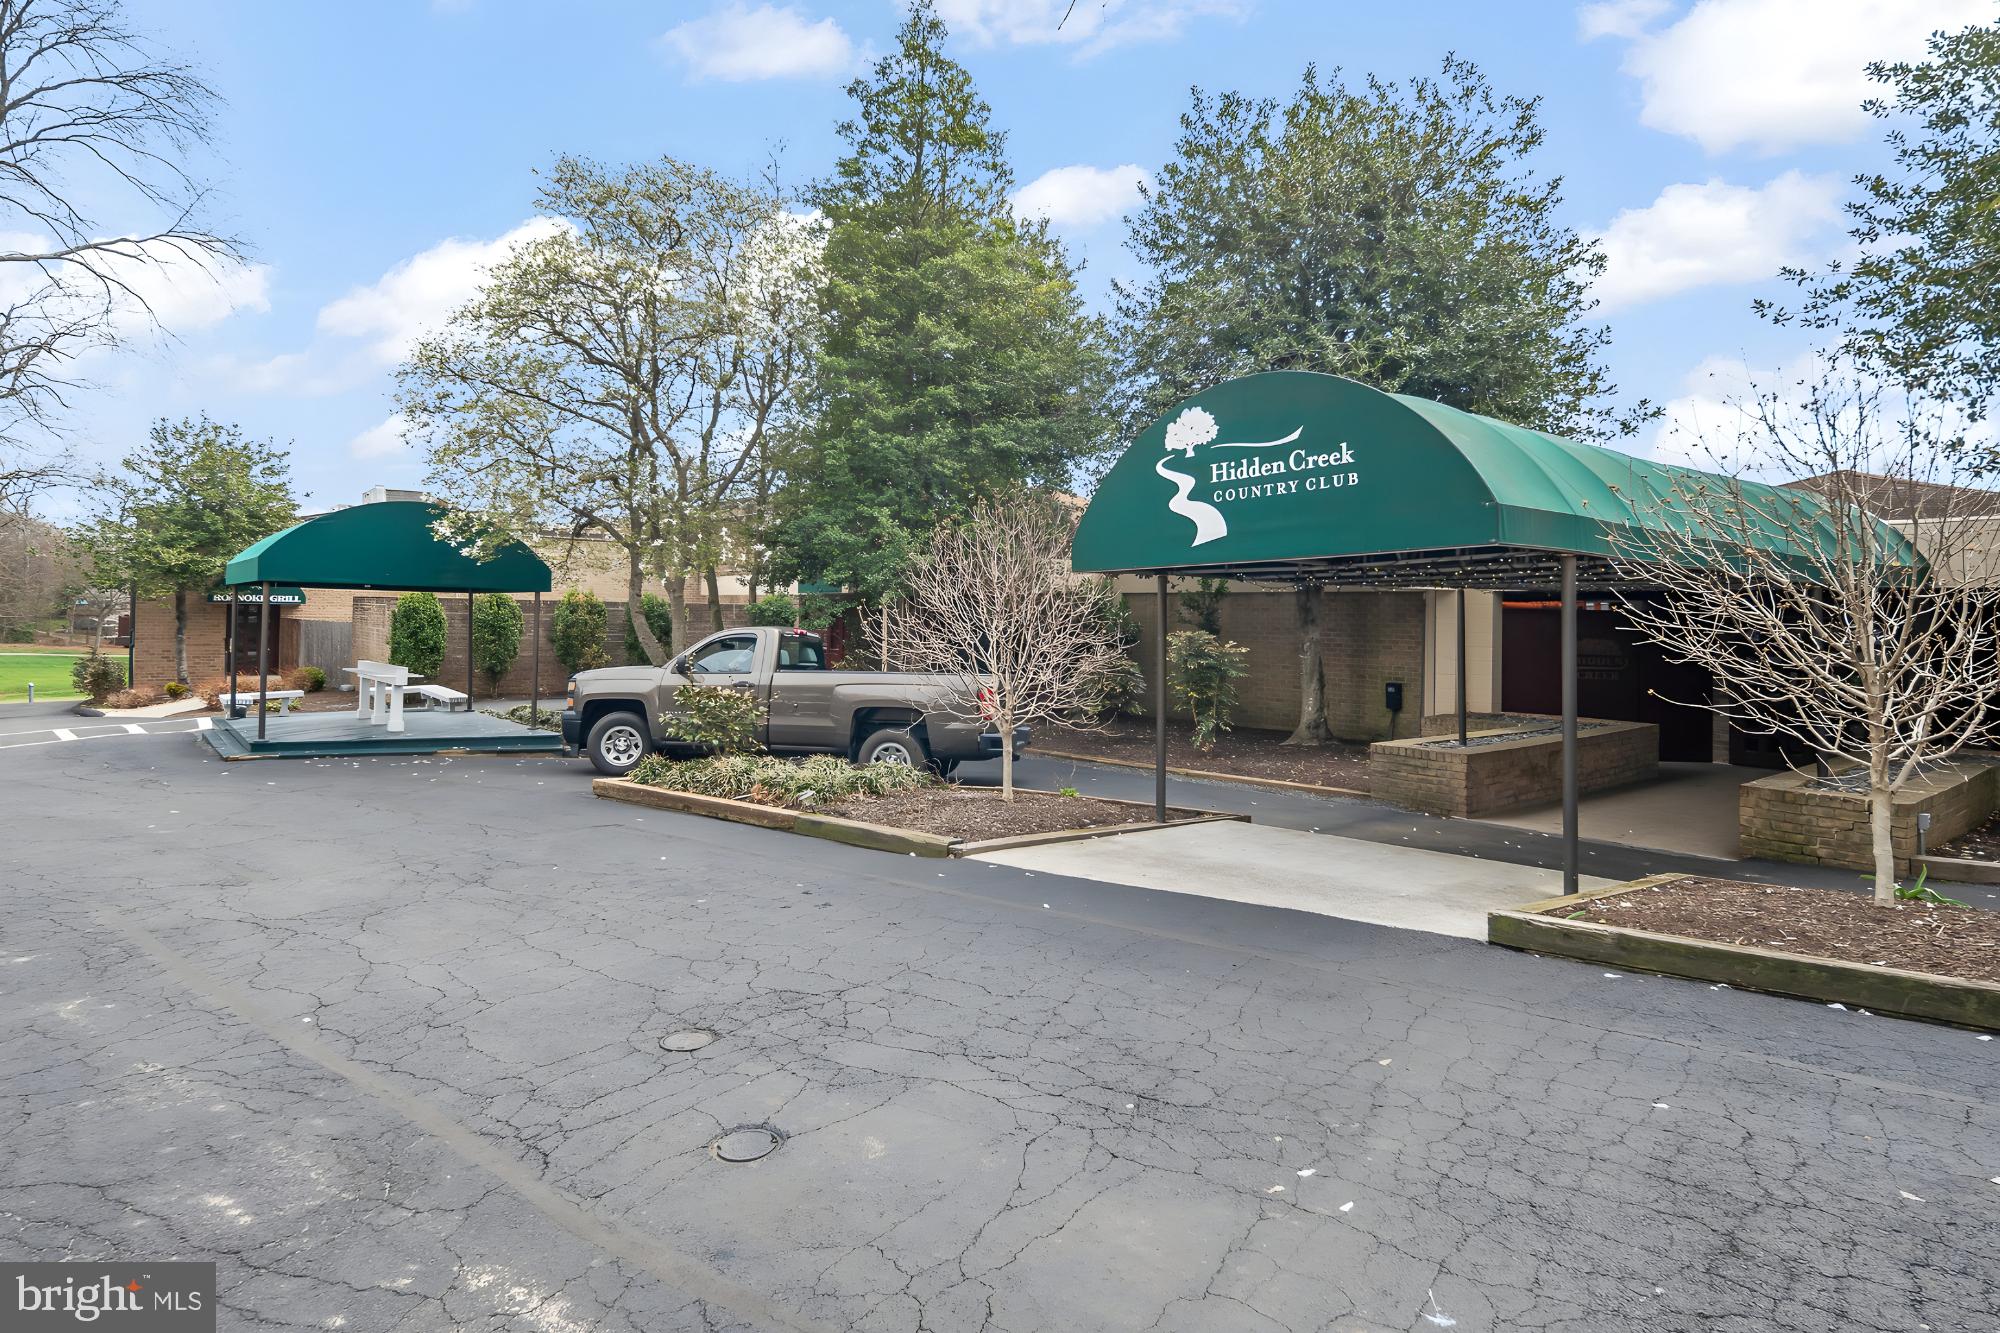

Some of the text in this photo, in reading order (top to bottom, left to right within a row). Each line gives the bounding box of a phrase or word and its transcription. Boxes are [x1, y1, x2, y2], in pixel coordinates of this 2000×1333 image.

[1210, 442, 1355, 483] Hidden Creek
[1213, 472, 1359, 502] COUNTRY CLUB
